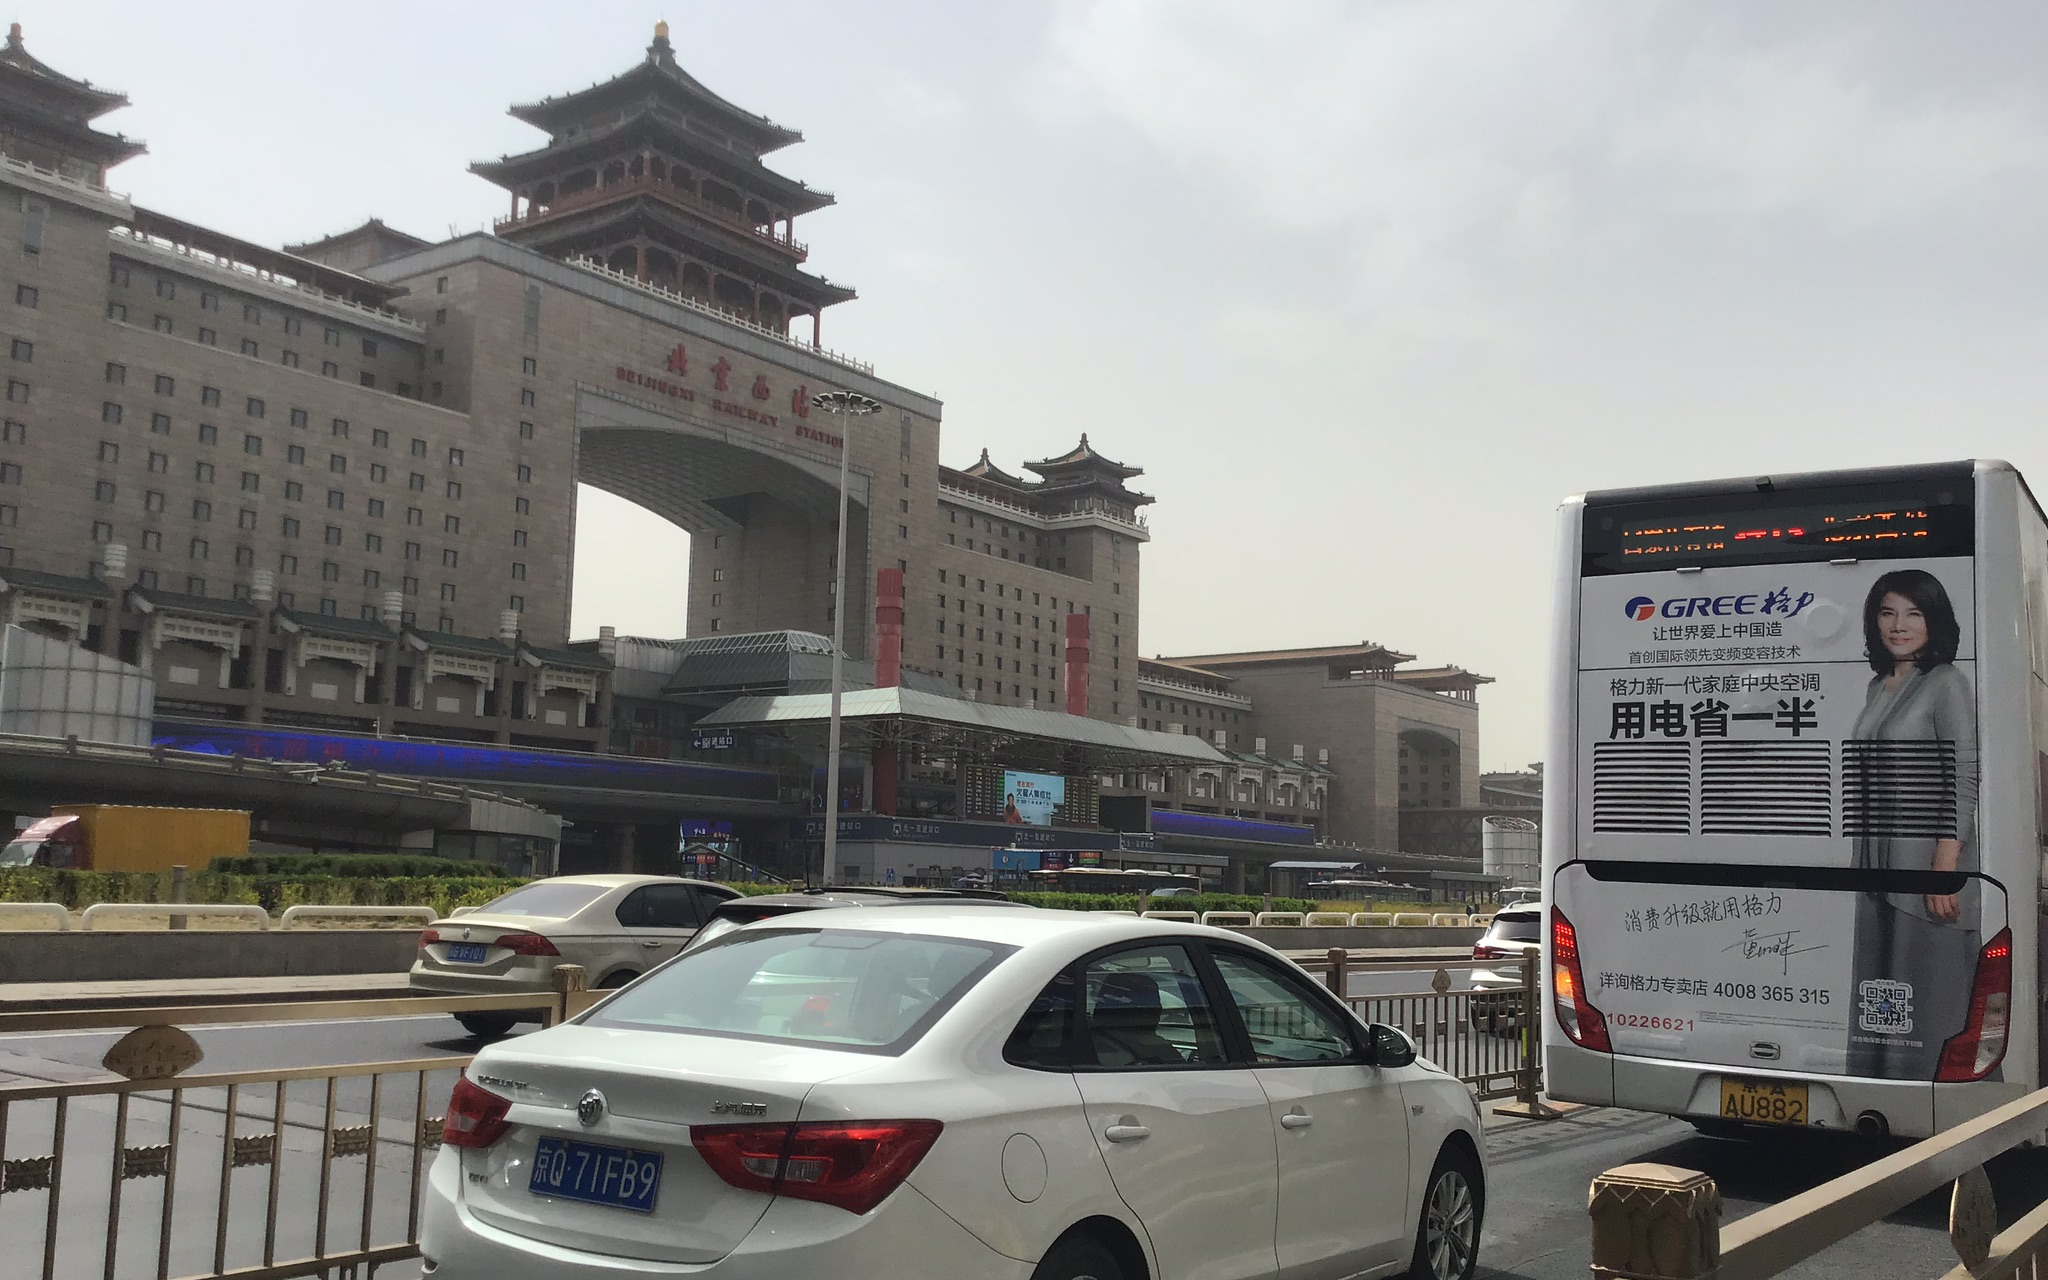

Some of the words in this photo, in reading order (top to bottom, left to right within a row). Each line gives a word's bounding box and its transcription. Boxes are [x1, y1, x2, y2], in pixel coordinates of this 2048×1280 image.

[712, 399, 779, 428] RAILWAY
[1661, 594, 1758, 619] GREE
[1759, 586, 1815, 619] 格力
[1652, 621, 1783, 642] 让世界爱上中国造
[1628, 645, 1802, 665] 首创国际领先变频变容技术
[1609, 673, 1821, 697] 格力新一代家庭中央空调
[1609, 696, 1818, 740] 用电省一半
[1624, 891, 1783, 933] 消费升级就用格力
[1600, 971, 1709, 997] 详询格力专卖店
[1713, 982, 1757, 1000] 4008
[1761, 985, 1795, 1003] 365
[1799, 988, 1831, 1005] 315
[1607, 1012, 1695, 1032] 10226621
[1725, 1093, 1804, 1123] AU882
